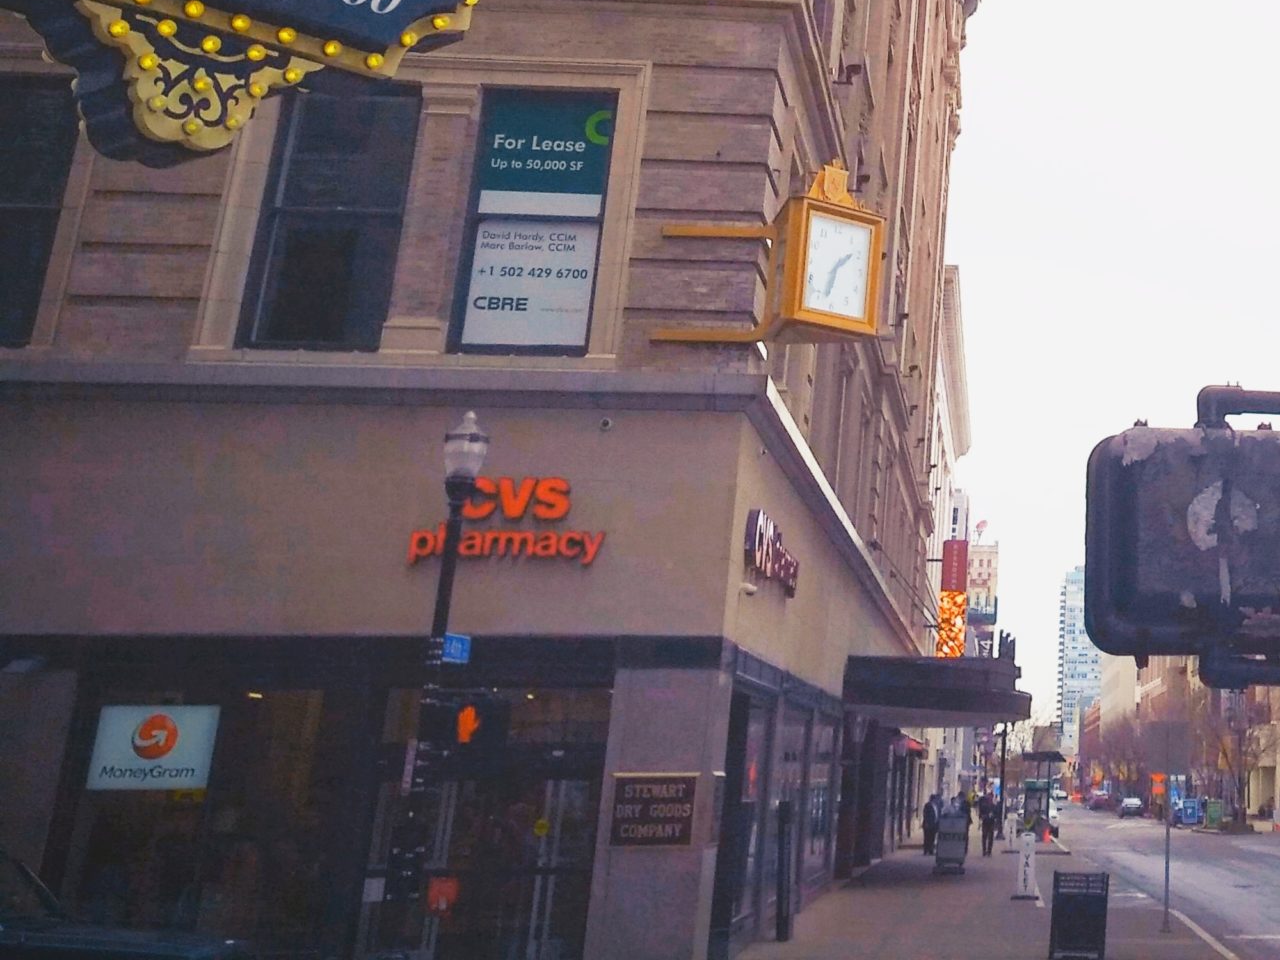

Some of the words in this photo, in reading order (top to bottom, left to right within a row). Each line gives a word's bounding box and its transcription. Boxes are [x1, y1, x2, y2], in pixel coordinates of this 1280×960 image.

[493, 134, 526, 150] For
[531, 135, 586, 153] Lease
[490, 158, 508, 170] Up
[511, 159, 522, 169] to
[525, 159, 567, 171] 50,000
[569, 161, 584, 171] SF
[549, 233, 577, 242] CCIM
[480, 242, 505, 250] Marc
[548, 242, 576, 252] CCIM
[478, 266, 494, 276] +1
[500, 267, 523, 277] 502
[527, 267, 552, 278] 429
[556, 269, 588, 280] 6700
[473, 296, 529, 312] CBRE
[462, 476, 571, 520] CVS
[99, 765, 196, 782] MoneyGram
[624, 784, 686, 798] STEWART
[616, 804, 643, 818] DRY
[649, 803, 692, 818] GOODS
[621, 823, 682, 838] COMPANY
